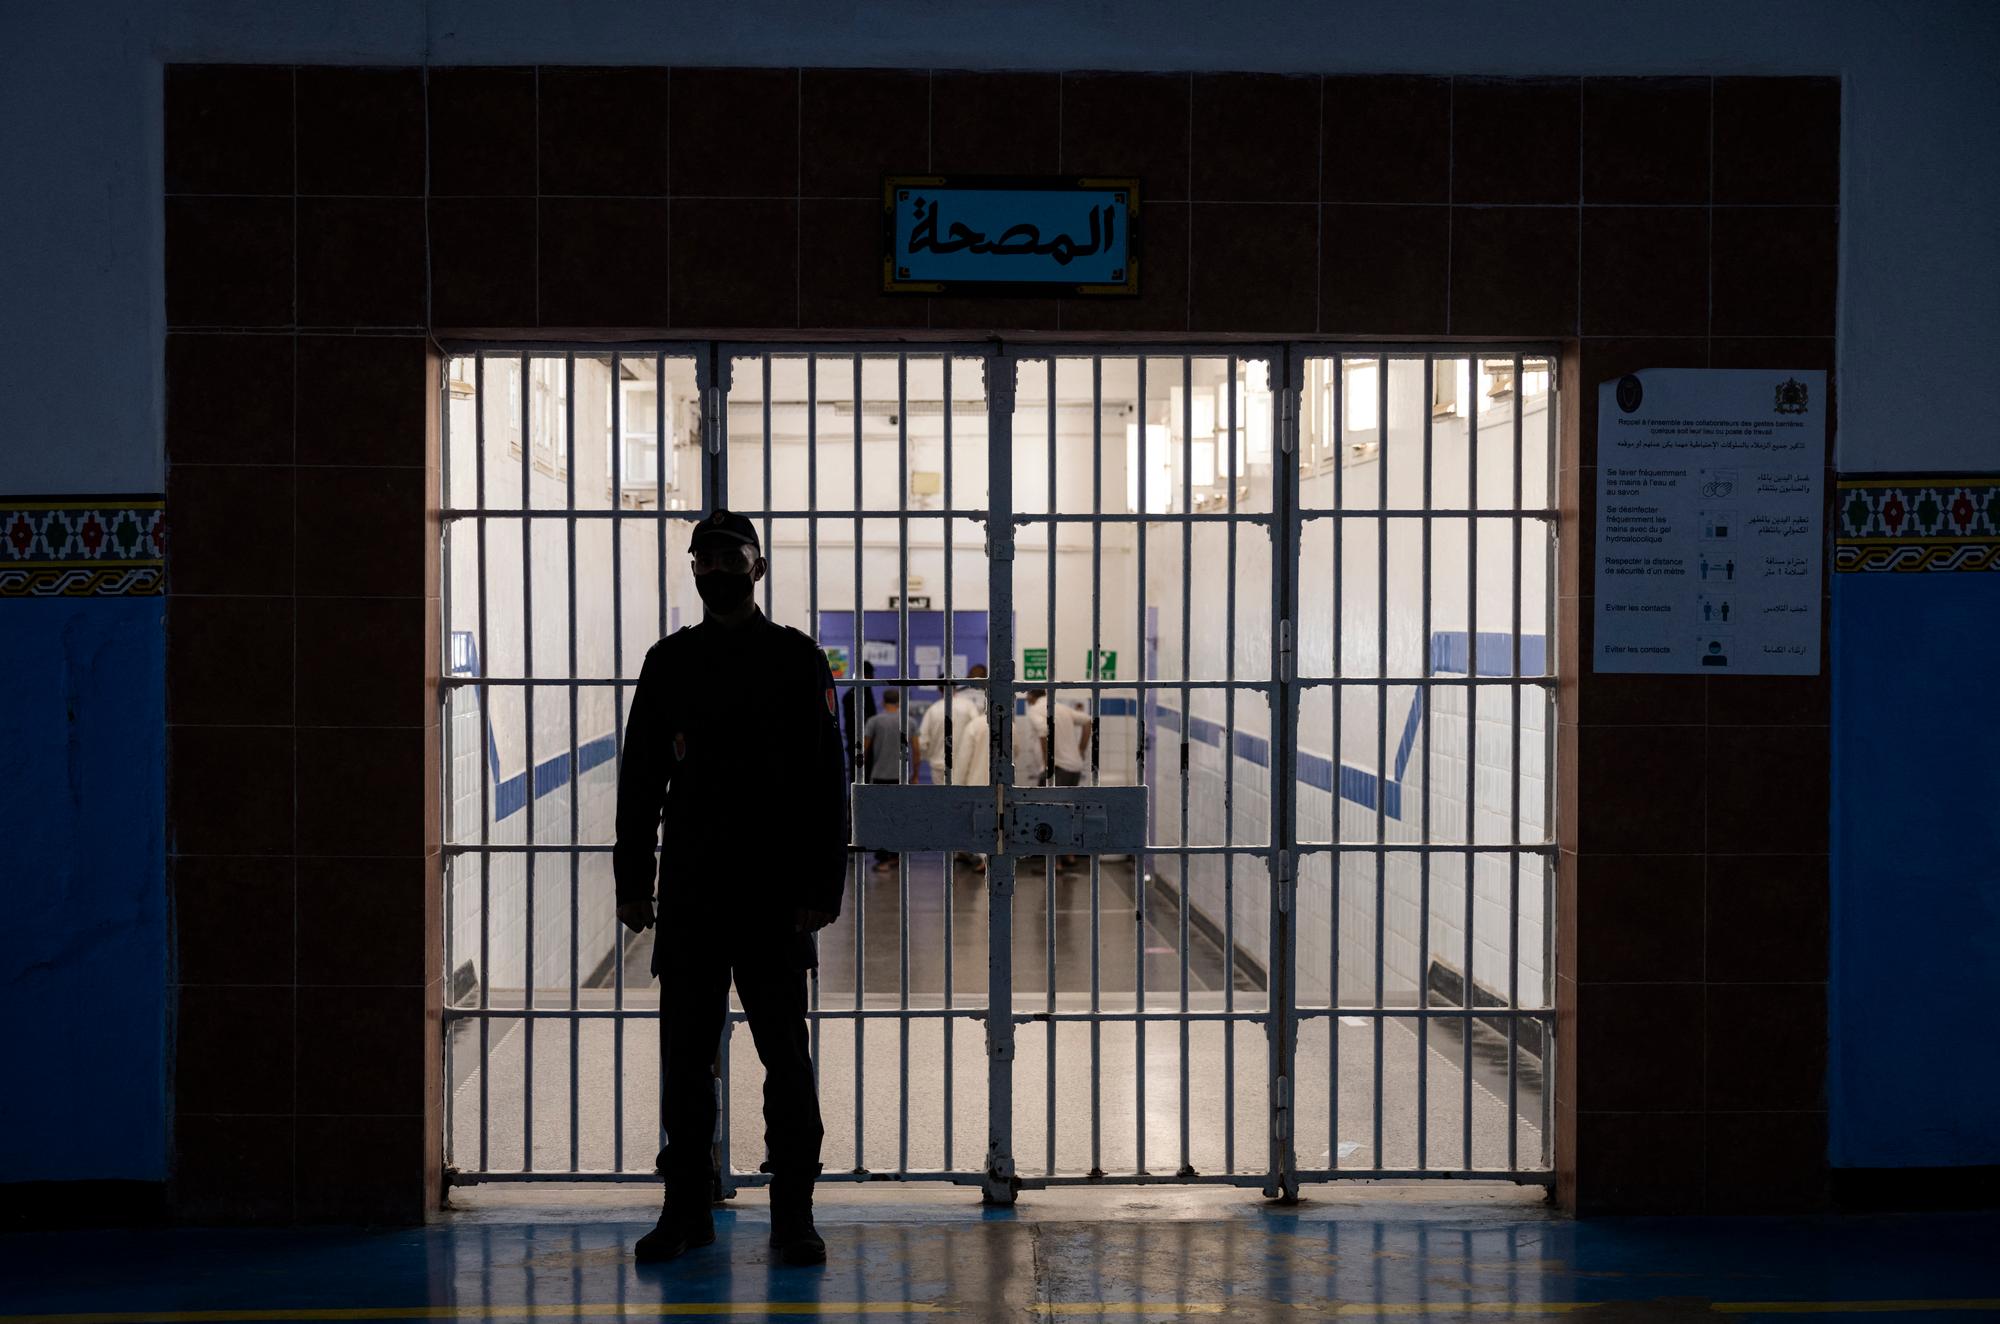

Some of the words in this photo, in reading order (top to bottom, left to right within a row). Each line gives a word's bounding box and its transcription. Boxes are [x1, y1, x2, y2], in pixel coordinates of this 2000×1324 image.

[908, 196, 1115, 266] المصحة
[1618, 418, 1640, 426] Rappel
[1753, 421, 1774, 429] gestes
[1618, 469, 1637, 477] laver
[1606, 525, 1628, 533] mains
[1652, 557, 1684, 565] distance
[1640, 603, 1671, 612] contacts
[1639, 645, 1671, 654] contacts
